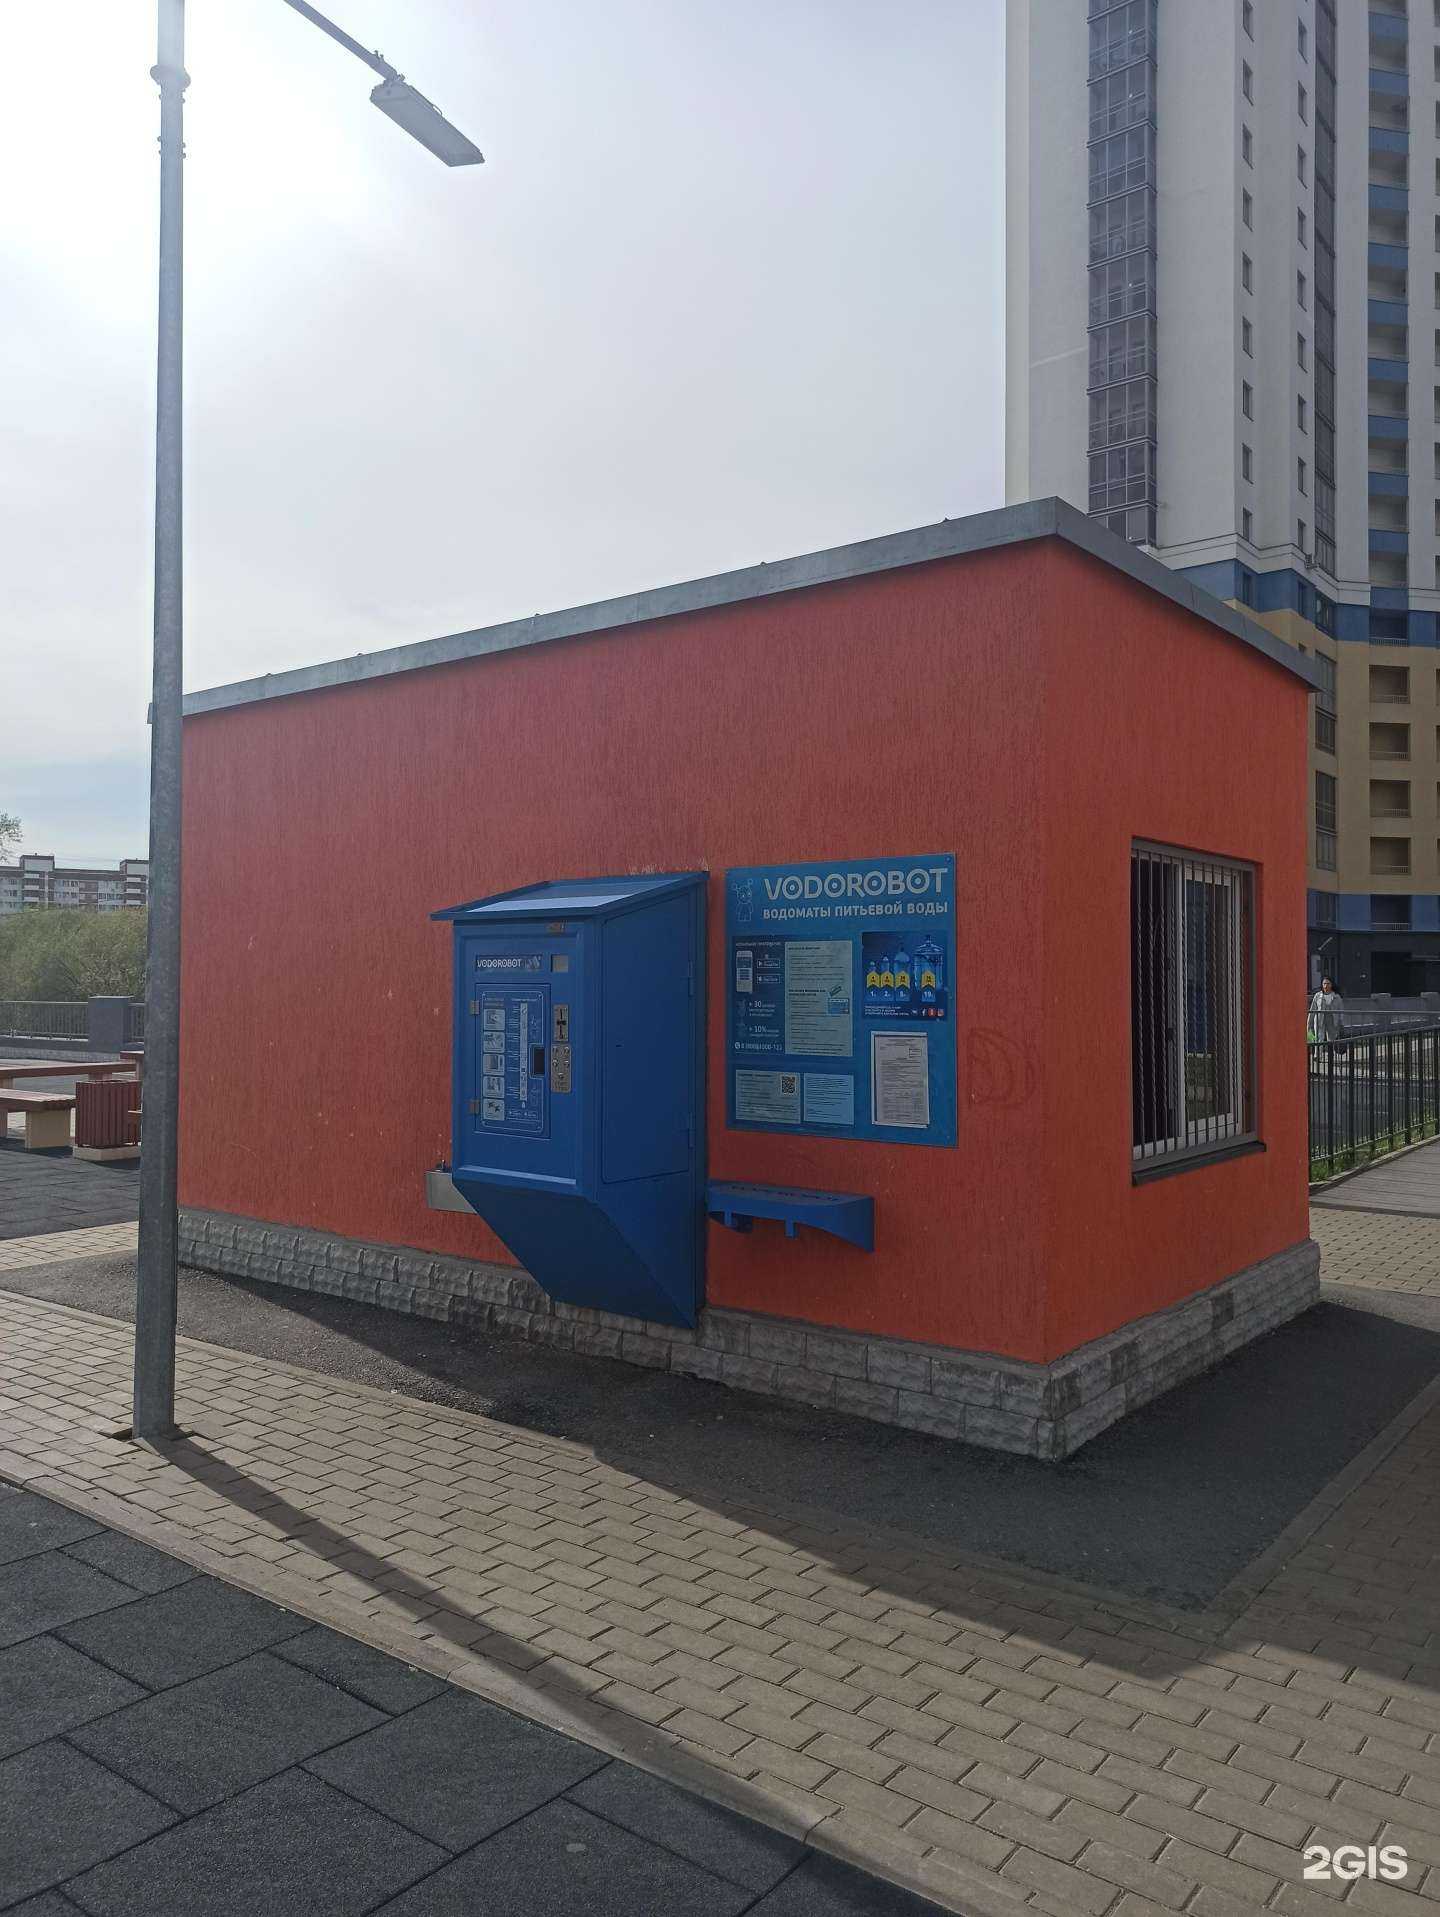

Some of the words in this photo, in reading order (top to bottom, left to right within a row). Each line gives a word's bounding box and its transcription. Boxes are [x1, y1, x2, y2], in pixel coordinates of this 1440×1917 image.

[763, 868, 949, 901] VODOROBOT
[763, 907, 832, 921] ВОДОМАТЫ
[834, 901, 904, 918] ПИТЬЕВОЙ
[907, 902, 949, 917] ВОДЫ
[477, 958, 522, 969] VODOROBOT
